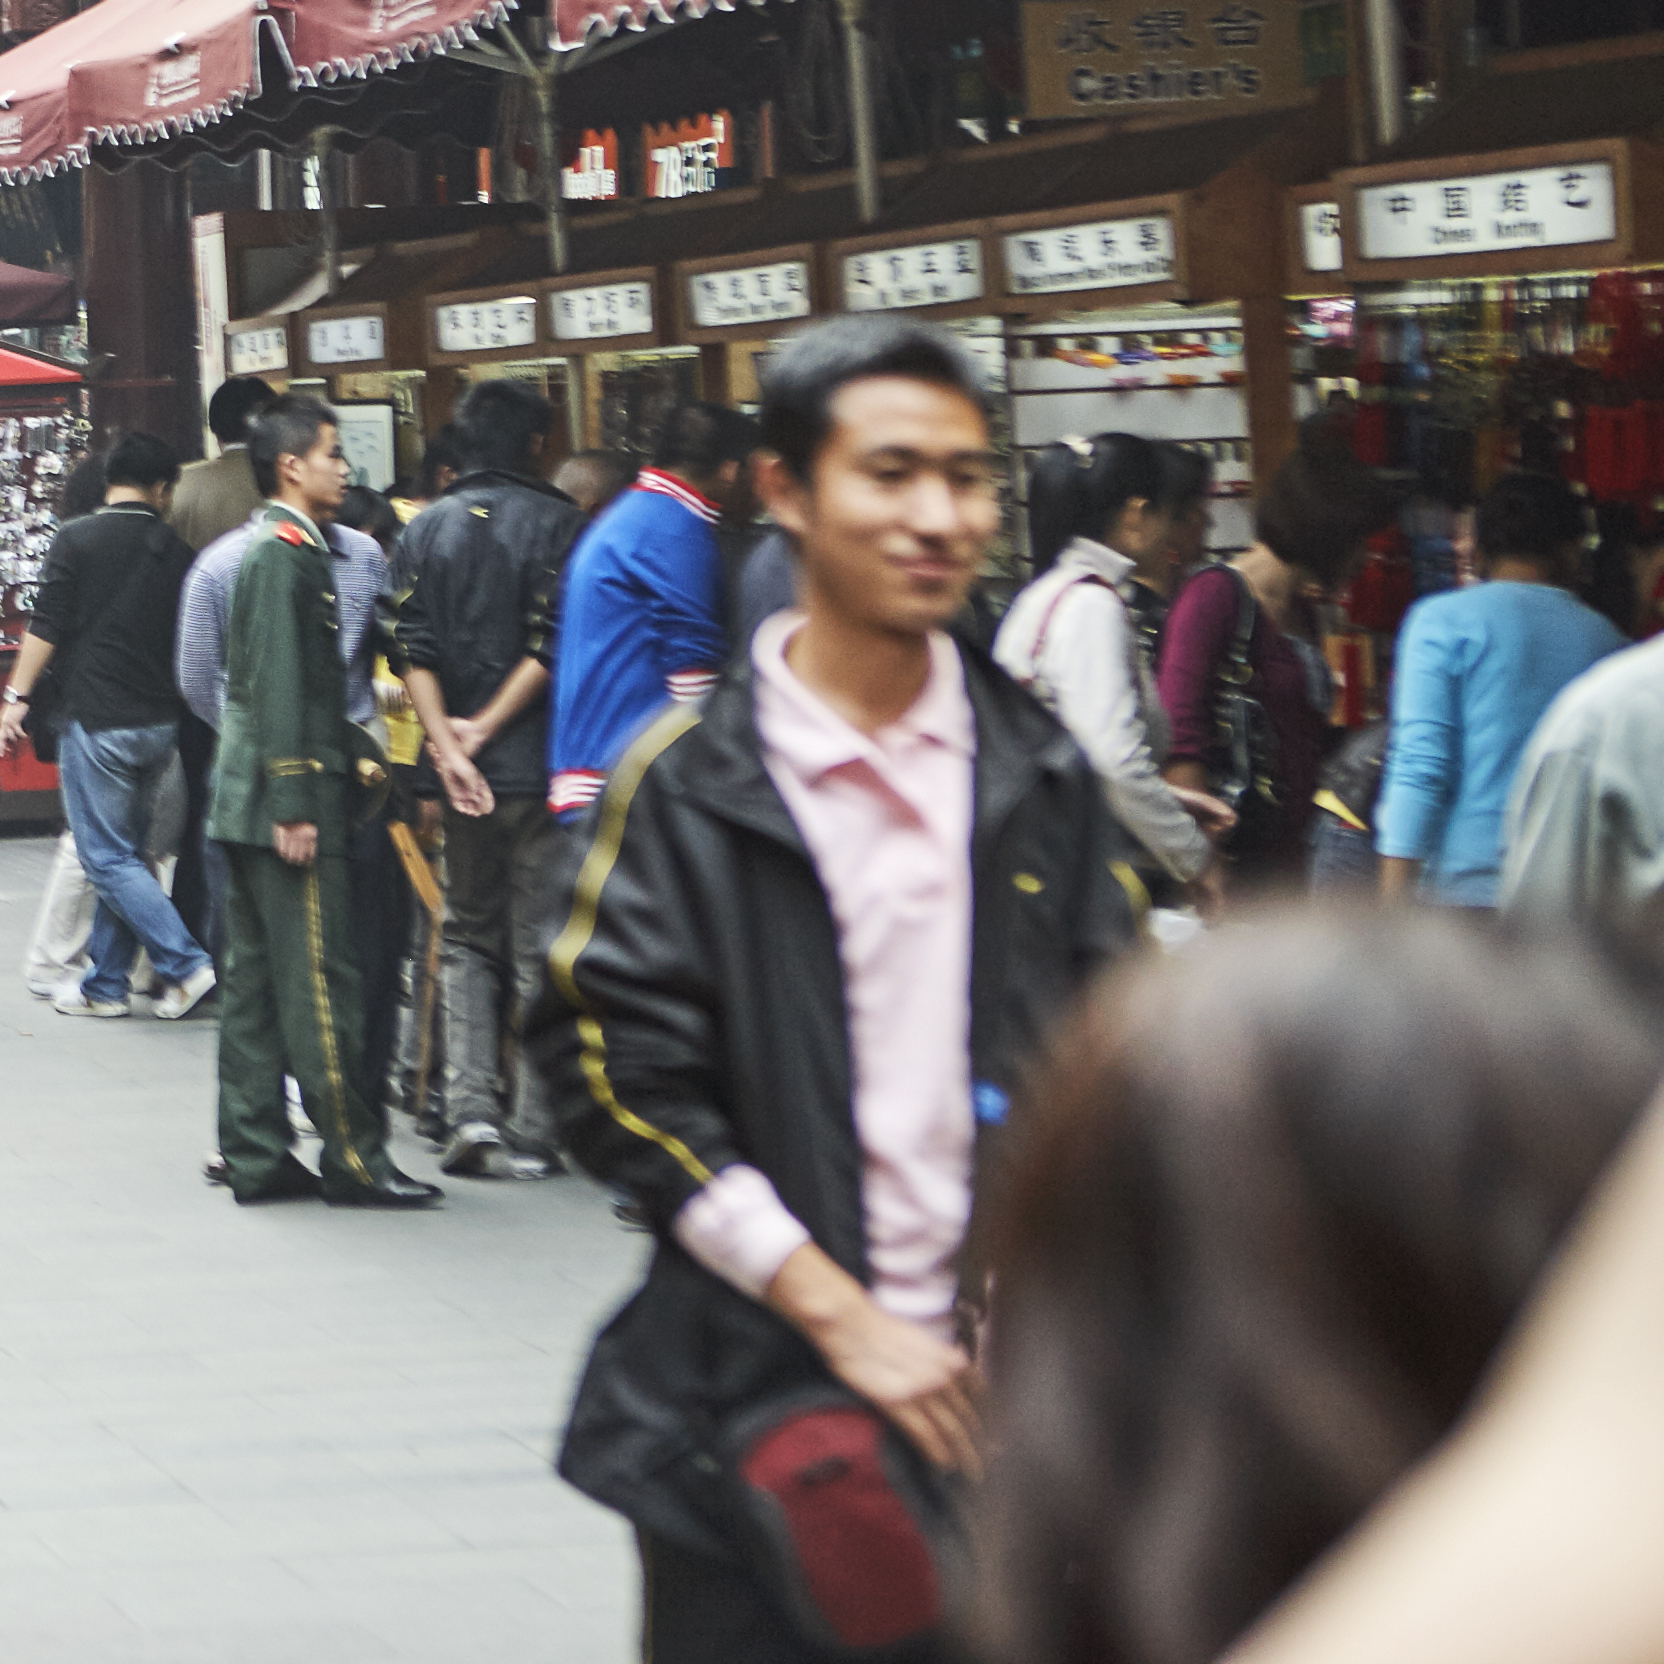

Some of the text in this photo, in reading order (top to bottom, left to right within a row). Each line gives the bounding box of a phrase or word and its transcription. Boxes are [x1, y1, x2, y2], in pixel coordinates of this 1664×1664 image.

[1057, 4, 1267, 55] 收银台
[1072, 60, 1260, 104] Cashier's
[1384, 170, 1592, 226] 中国结艺
